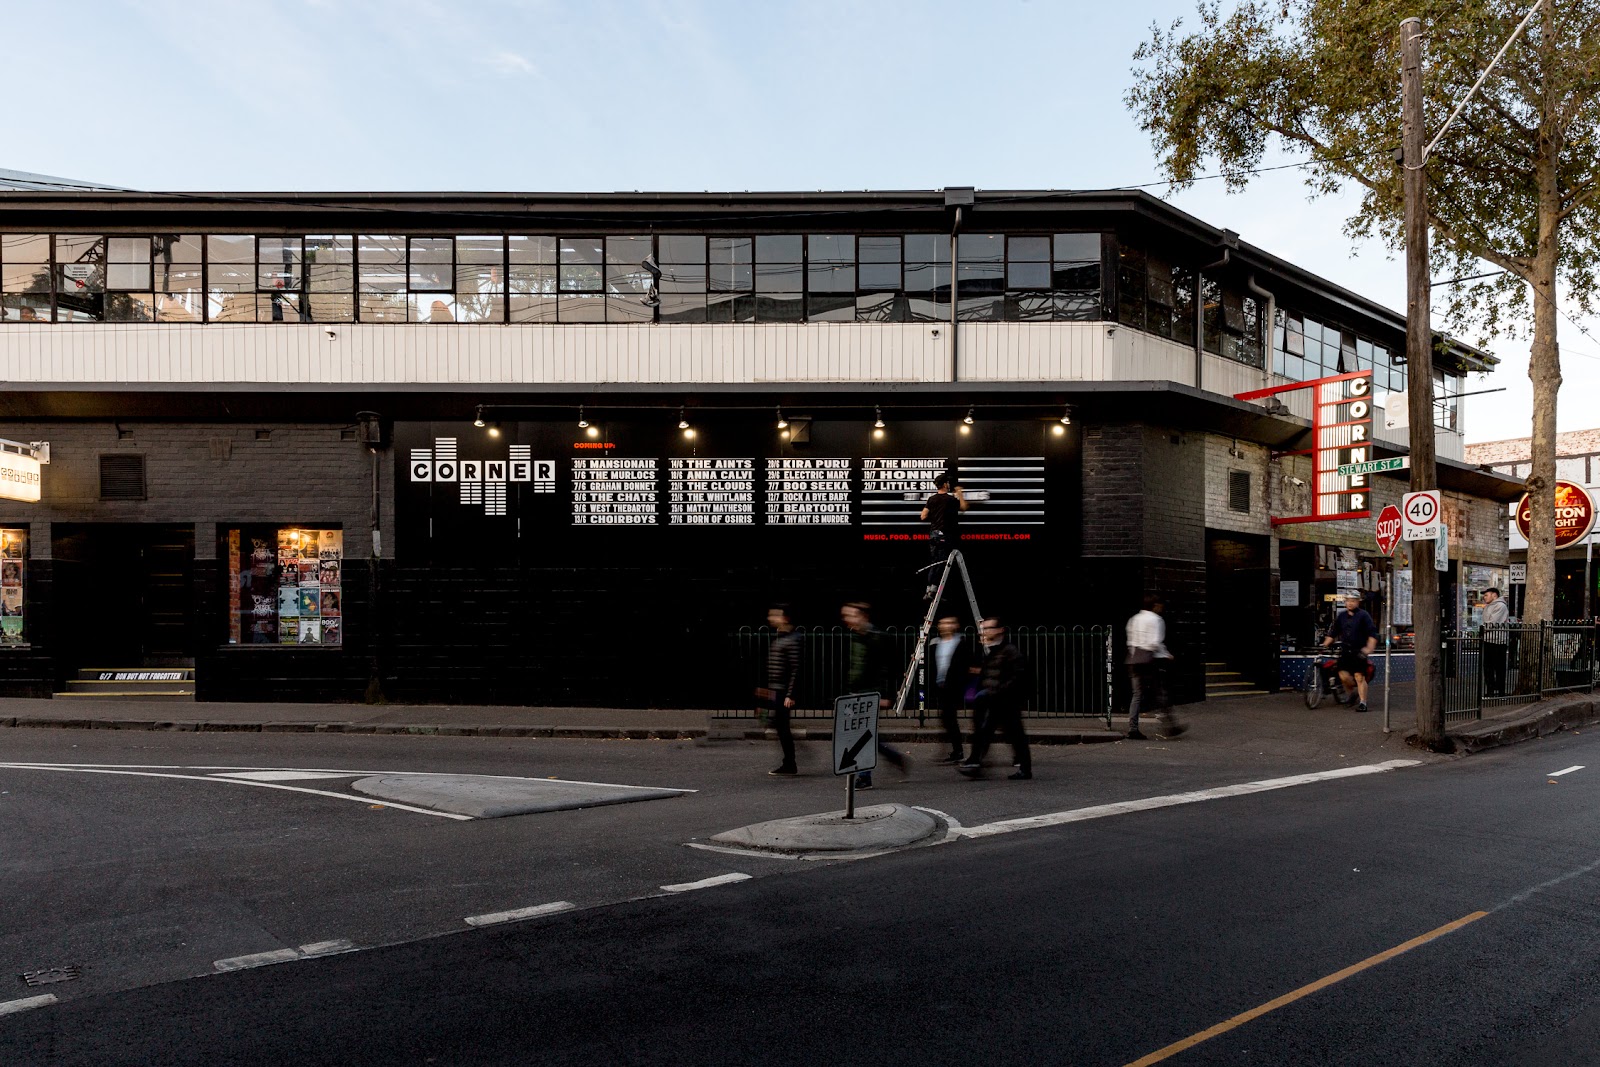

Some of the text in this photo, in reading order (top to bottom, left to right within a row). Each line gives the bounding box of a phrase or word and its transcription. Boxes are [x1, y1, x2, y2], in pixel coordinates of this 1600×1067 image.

[1350, 377, 1369, 510] CORNER
[590, 460, 655, 468] MANSIONAIR
[671, 460, 752, 468] 14/6 THE AINTS
[783, 460, 812, 468] KIRA
[816, 460, 849, 468] PURU
[1340, 462, 1378, 475] STEWART
[1381, 460, 1390, 470] ST
[412, 462, 552, 480] CORNER
[574, 471, 655, 479] 1/6 THE MURLOCS
[687, 471, 717, 479] ANNA
[721, 471, 752, 479] CALVI
[784, 471, 824, 479] ELECTRIC
[827, 471, 849, 479] MARY
[574, 482, 586, 490] 7/6
[624, 482, 655, 490] BONNET
[687, 482, 708, 490] THE
[711, 482, 752, 490] CLOUDS
[768, 482, 849, 490] 7/7 BOO SEEKA
[574, 504, 655, 512] 9/6 WEST THEBARTON
[687, 504, 711, 512] MATTY
[713, 504, 752, 512] MATHESON
[768, 504, 849, 512] 12/7 BEARTOOTH
[1410, 502, 1432, 516] 40
[1522, 506, 1585, 521] CTON
[590, 515, 656, 523] CHOIRBOYS
[687, 515, 709, 523] BORN
[712, 515, 722, 523] OF
[725, 515, 752, 523] OSIRIS
[784, 515, 798, 523] THY
[798, 515, 811, 523] ART
[813, 515, 819, 523] IS
[821, 515, 849, 523] MURDER
[1377, 518, 1400, 538] STOP
[1407, 529, 1412, 538] 7
[844, 717, 870, 731] LEFT
